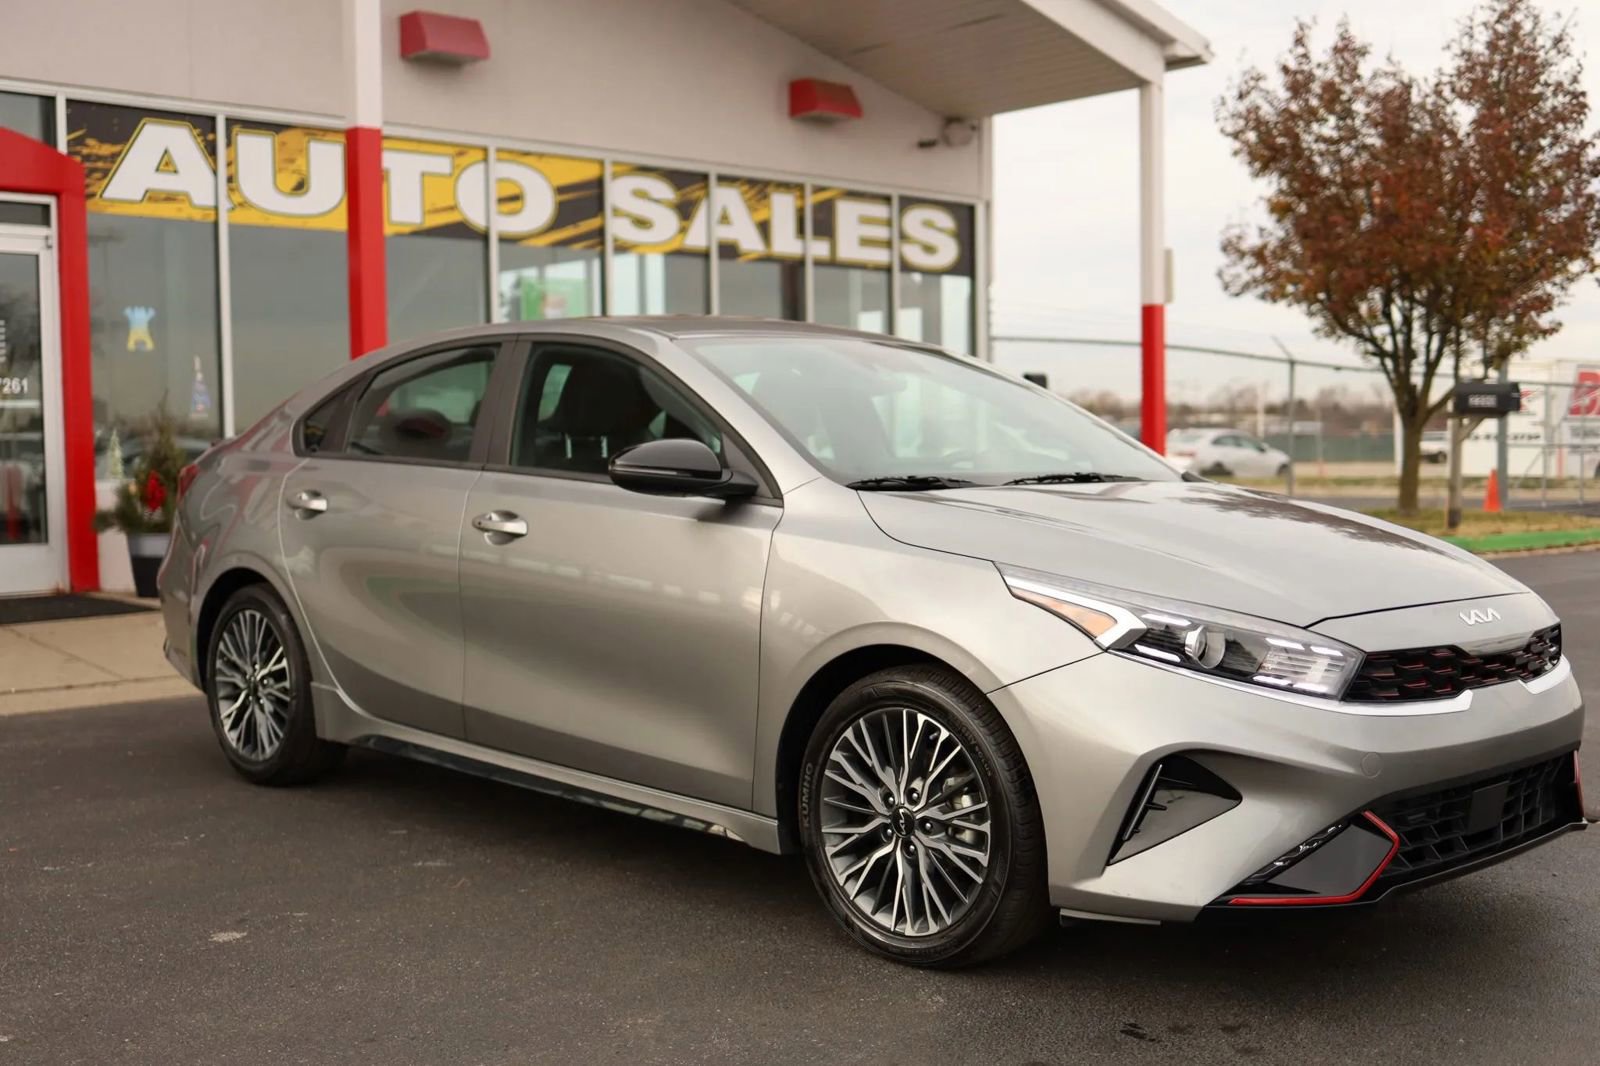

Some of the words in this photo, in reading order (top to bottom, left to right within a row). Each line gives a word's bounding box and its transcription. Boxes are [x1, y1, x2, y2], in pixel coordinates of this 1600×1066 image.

[101, 117, 558, 236] AUTO
[609, 173, 961, 271] SALES
[0, 377, 28, 394] 261
[801, 761, 814, 828] KUMHO
